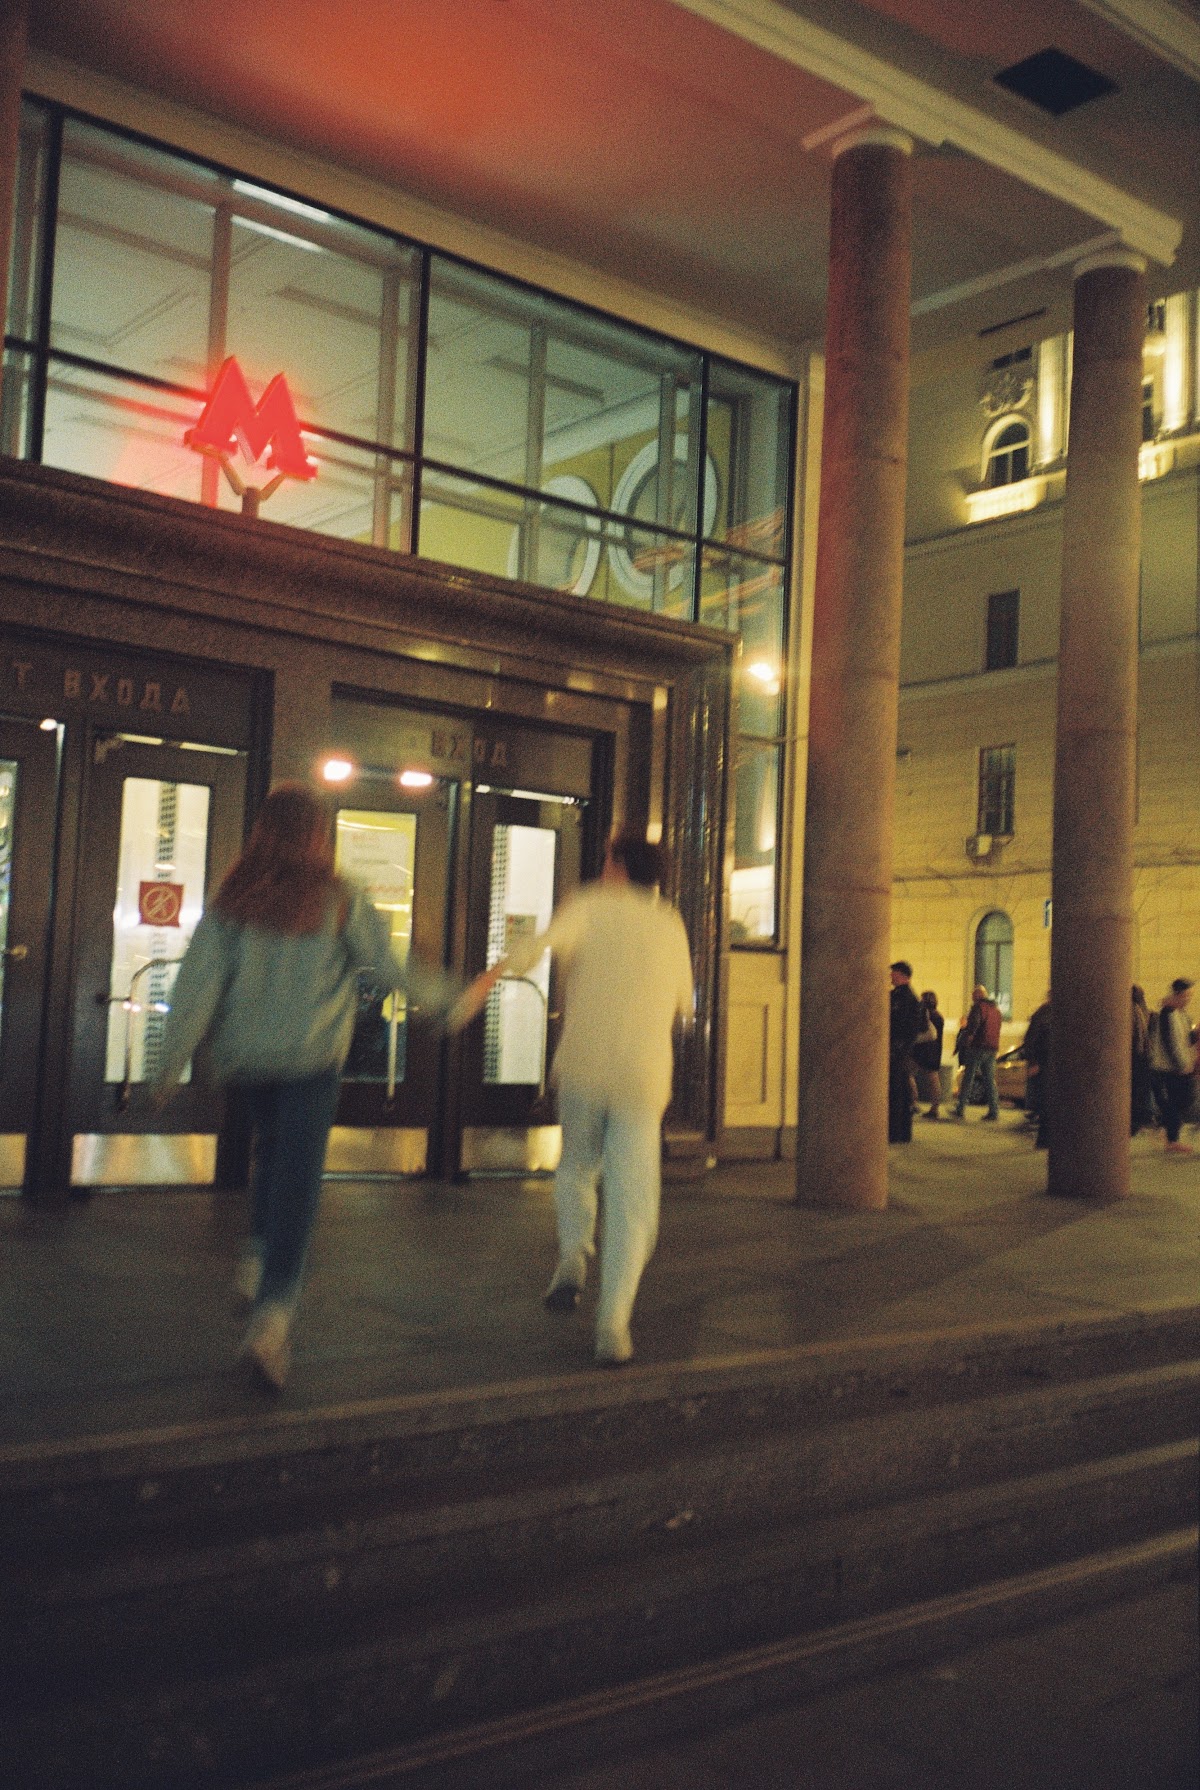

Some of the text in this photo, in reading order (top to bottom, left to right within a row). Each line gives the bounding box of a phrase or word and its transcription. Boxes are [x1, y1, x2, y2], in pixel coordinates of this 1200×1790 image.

[184, 354, 318, 481] М
[63, 669, 191, 714] ВХОДА
[431, 730, 507, 768] ВХОД
